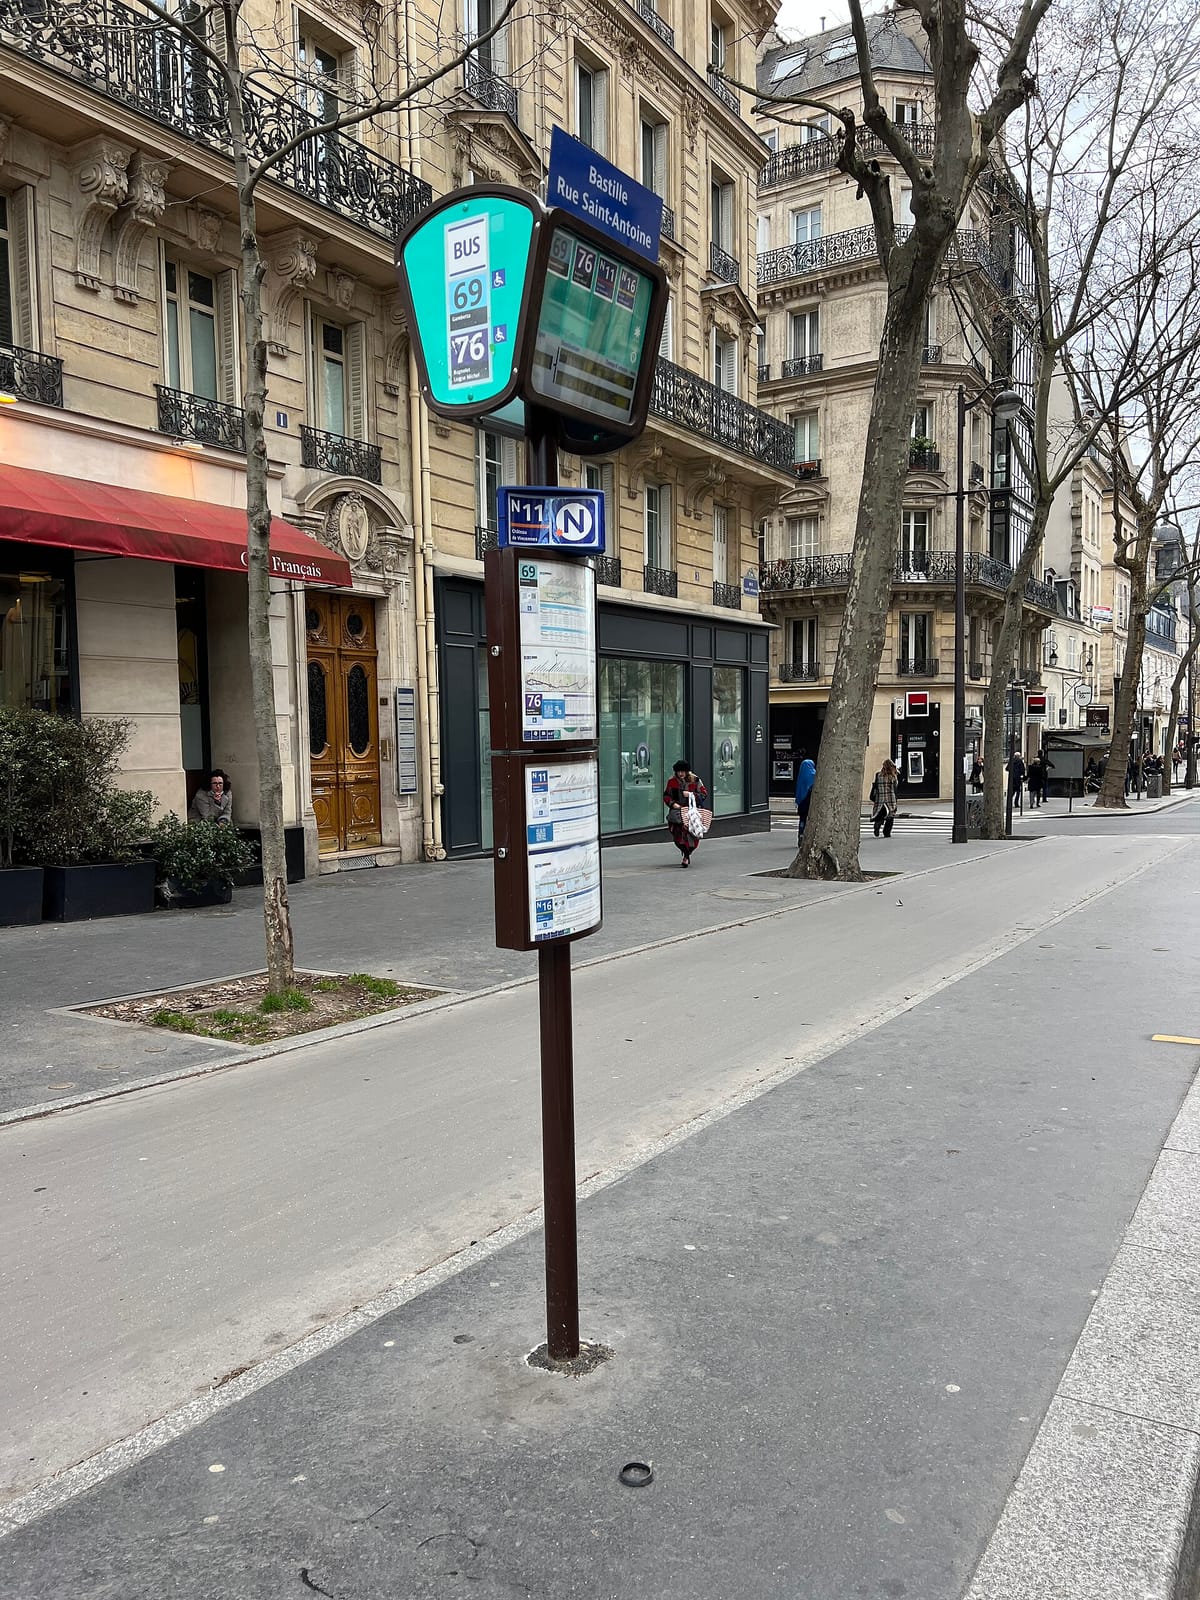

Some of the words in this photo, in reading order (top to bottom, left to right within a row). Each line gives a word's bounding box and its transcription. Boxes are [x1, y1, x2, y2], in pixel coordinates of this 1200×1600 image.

[588, 165, 628, 207] Bastille
[557, 175, 580, 205] Rue
[581, 192, 652, 250] Saint-Antoine
[453, 236, 481, 260] BUS
[553, 237, 569, 259] 69
[577, 249, 594, 273] 76
[599, 259, 615, 282] N11
[621, 271, 637, 293] N16
[453, 278, 483, 310] 69
[454, 331, 485, 364] 76
[280, 413, 285, 427] 1
[511, 499, 544, 522] N11
[563, 508, 585, 534] N
[271, 555, 322, 579] Français
[521, 565, 536, 578] 69
[527, 694, 541, 707] 76
[536, 901, 552, 912] N16
